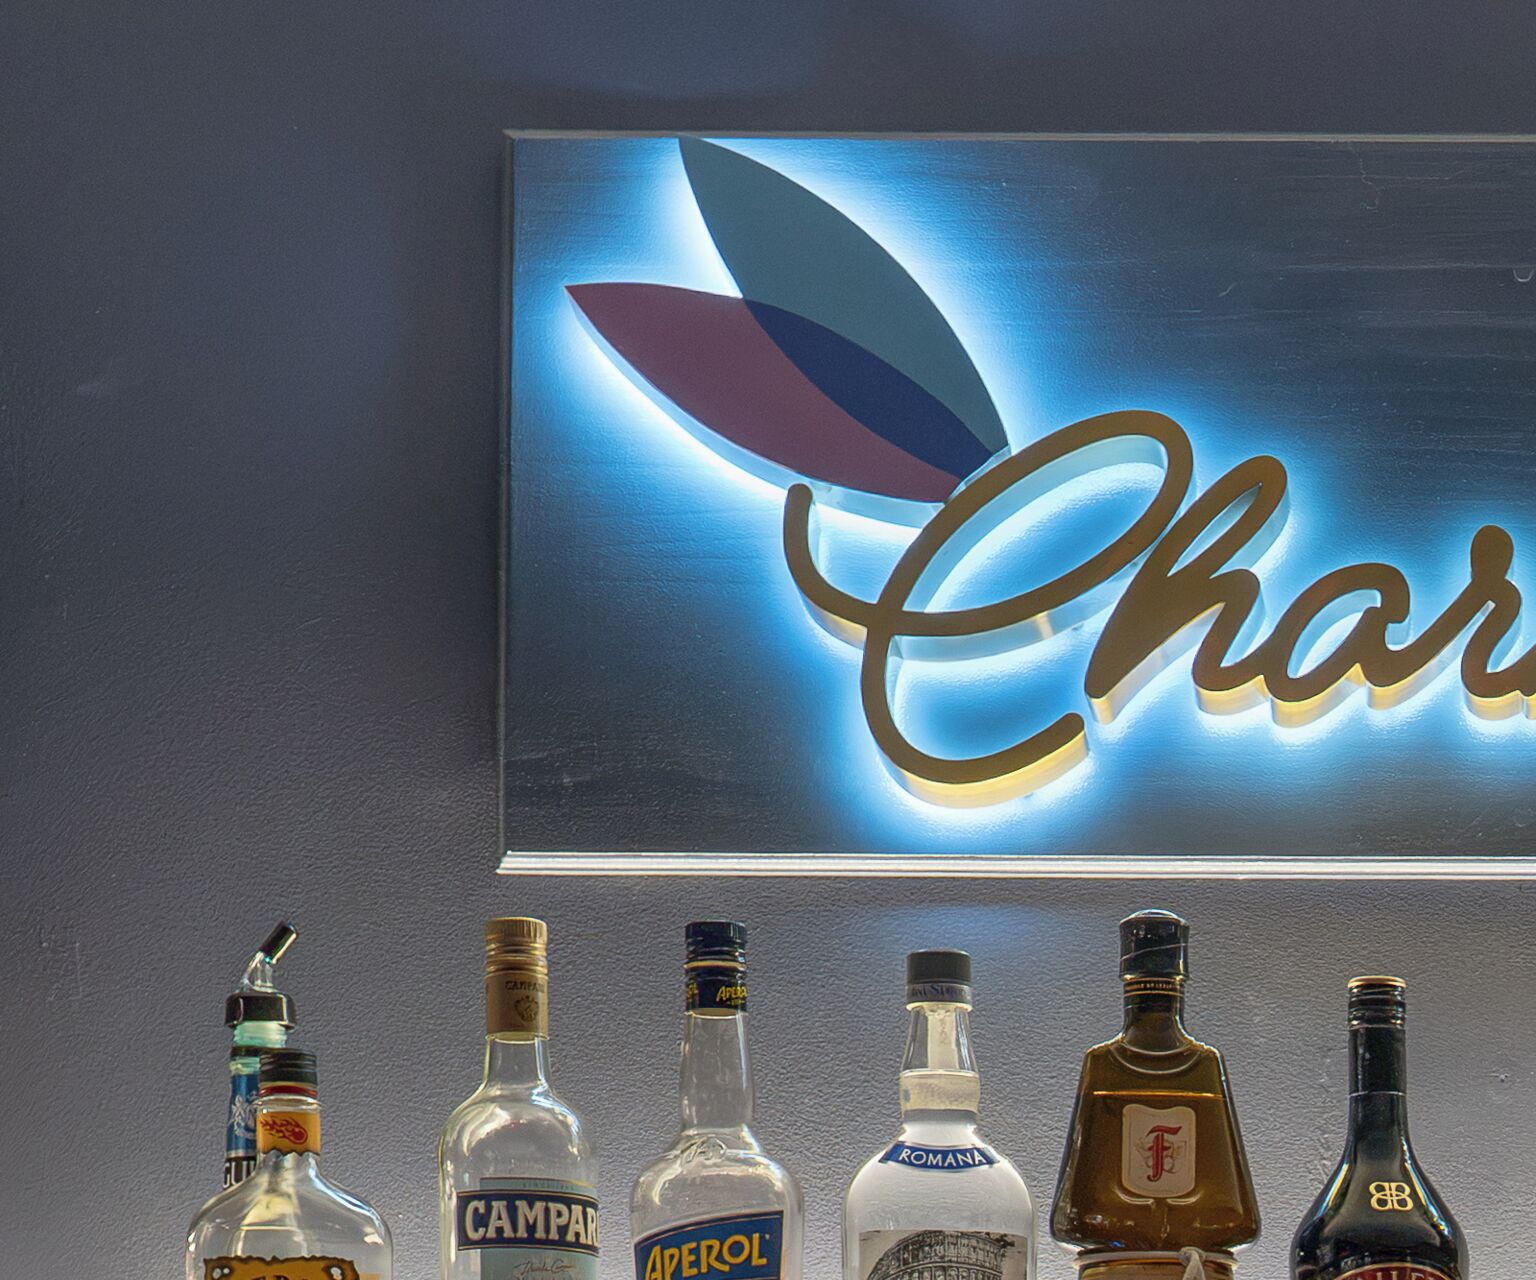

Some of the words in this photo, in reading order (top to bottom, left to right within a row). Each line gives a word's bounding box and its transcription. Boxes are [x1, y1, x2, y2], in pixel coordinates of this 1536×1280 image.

[900, 1147, 986, 1168] ROMANA
[1146, 1124, 1183, 1182] F
[465, 1200, 599, 1248] CAMPAR
